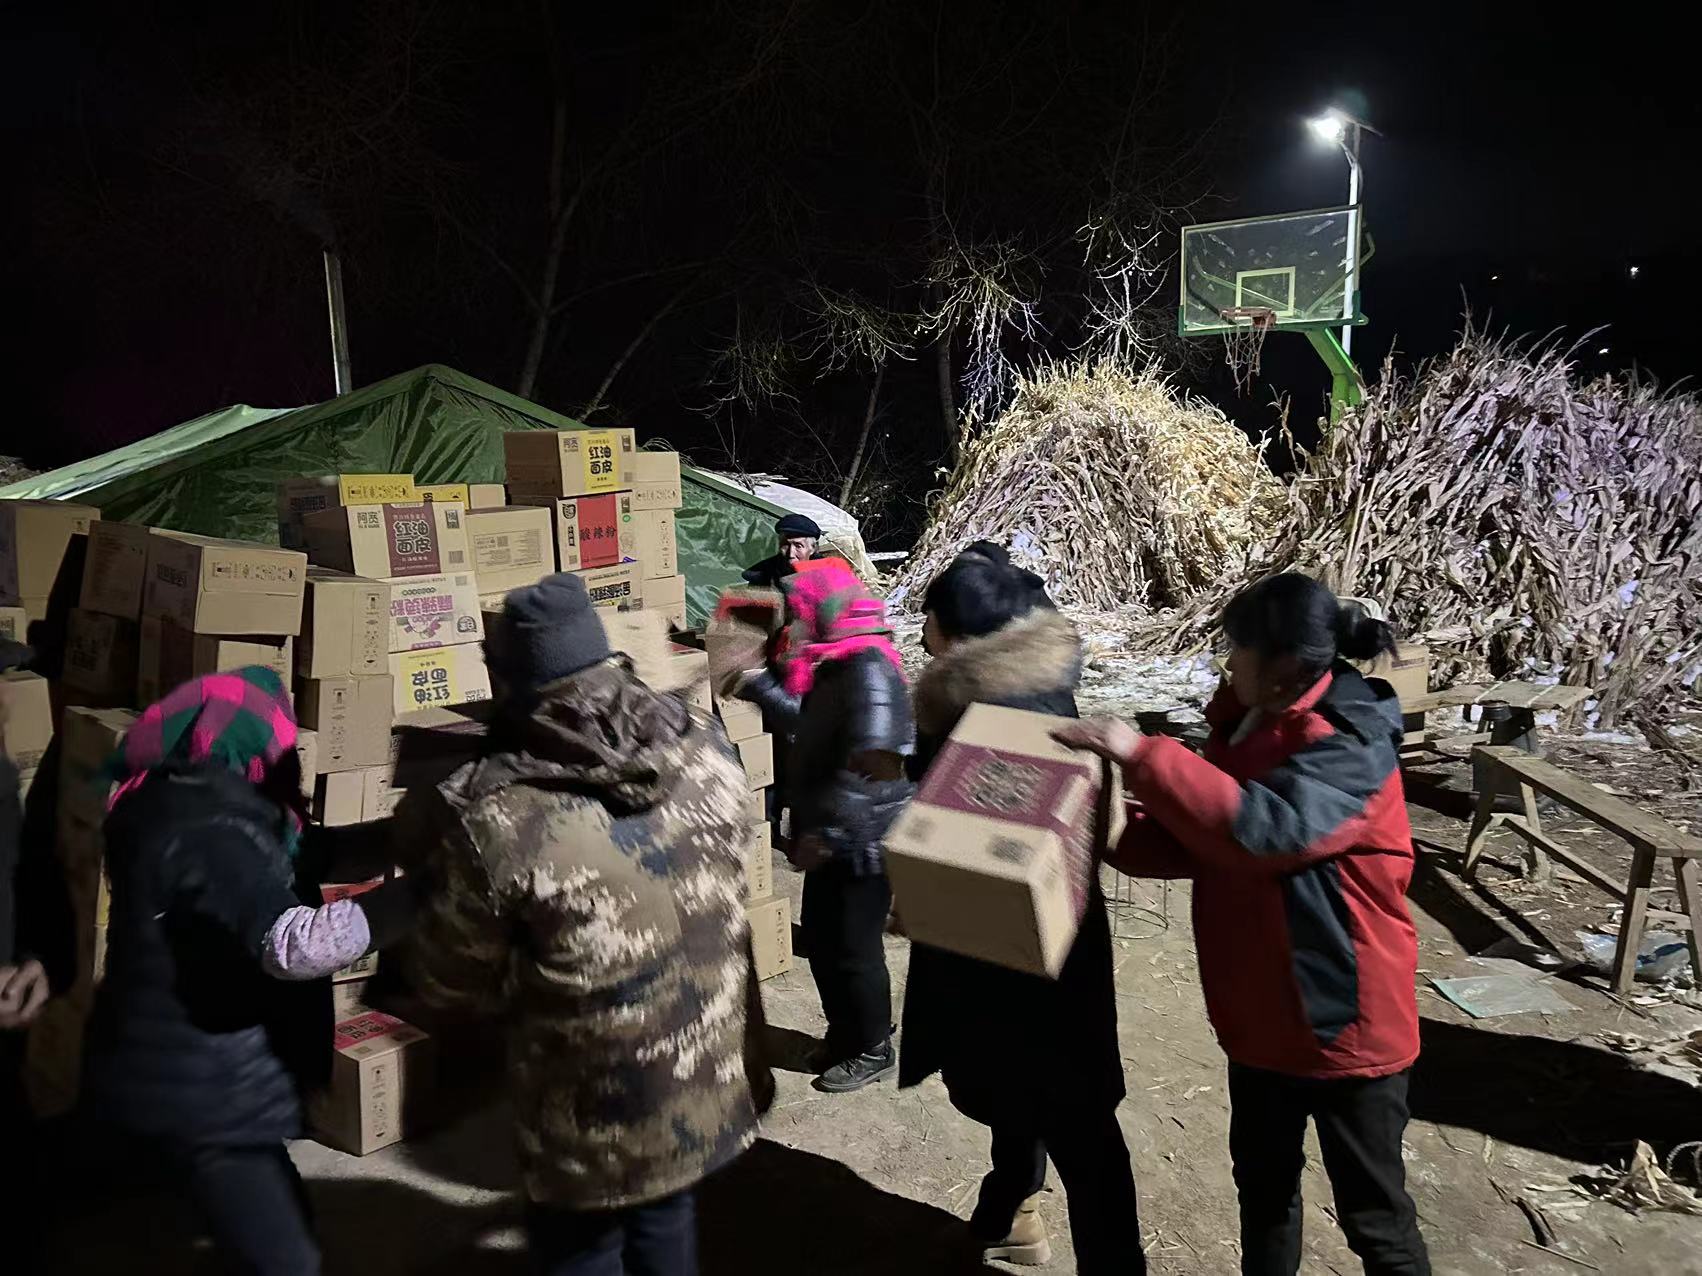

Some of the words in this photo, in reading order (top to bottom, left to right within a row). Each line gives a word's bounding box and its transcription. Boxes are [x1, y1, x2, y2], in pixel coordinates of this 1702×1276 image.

[588, 445, 612, 460] 红油
[589, 460, 613, 475] 面皮
[393, 520, 429, 537] 红油
[579, 525, 617, 541] 酸辣粉
[396, 537, 431, 554] 面皮
[412, 668, 448, 687] 面皮
[414, 685, 450, 704] 红油
